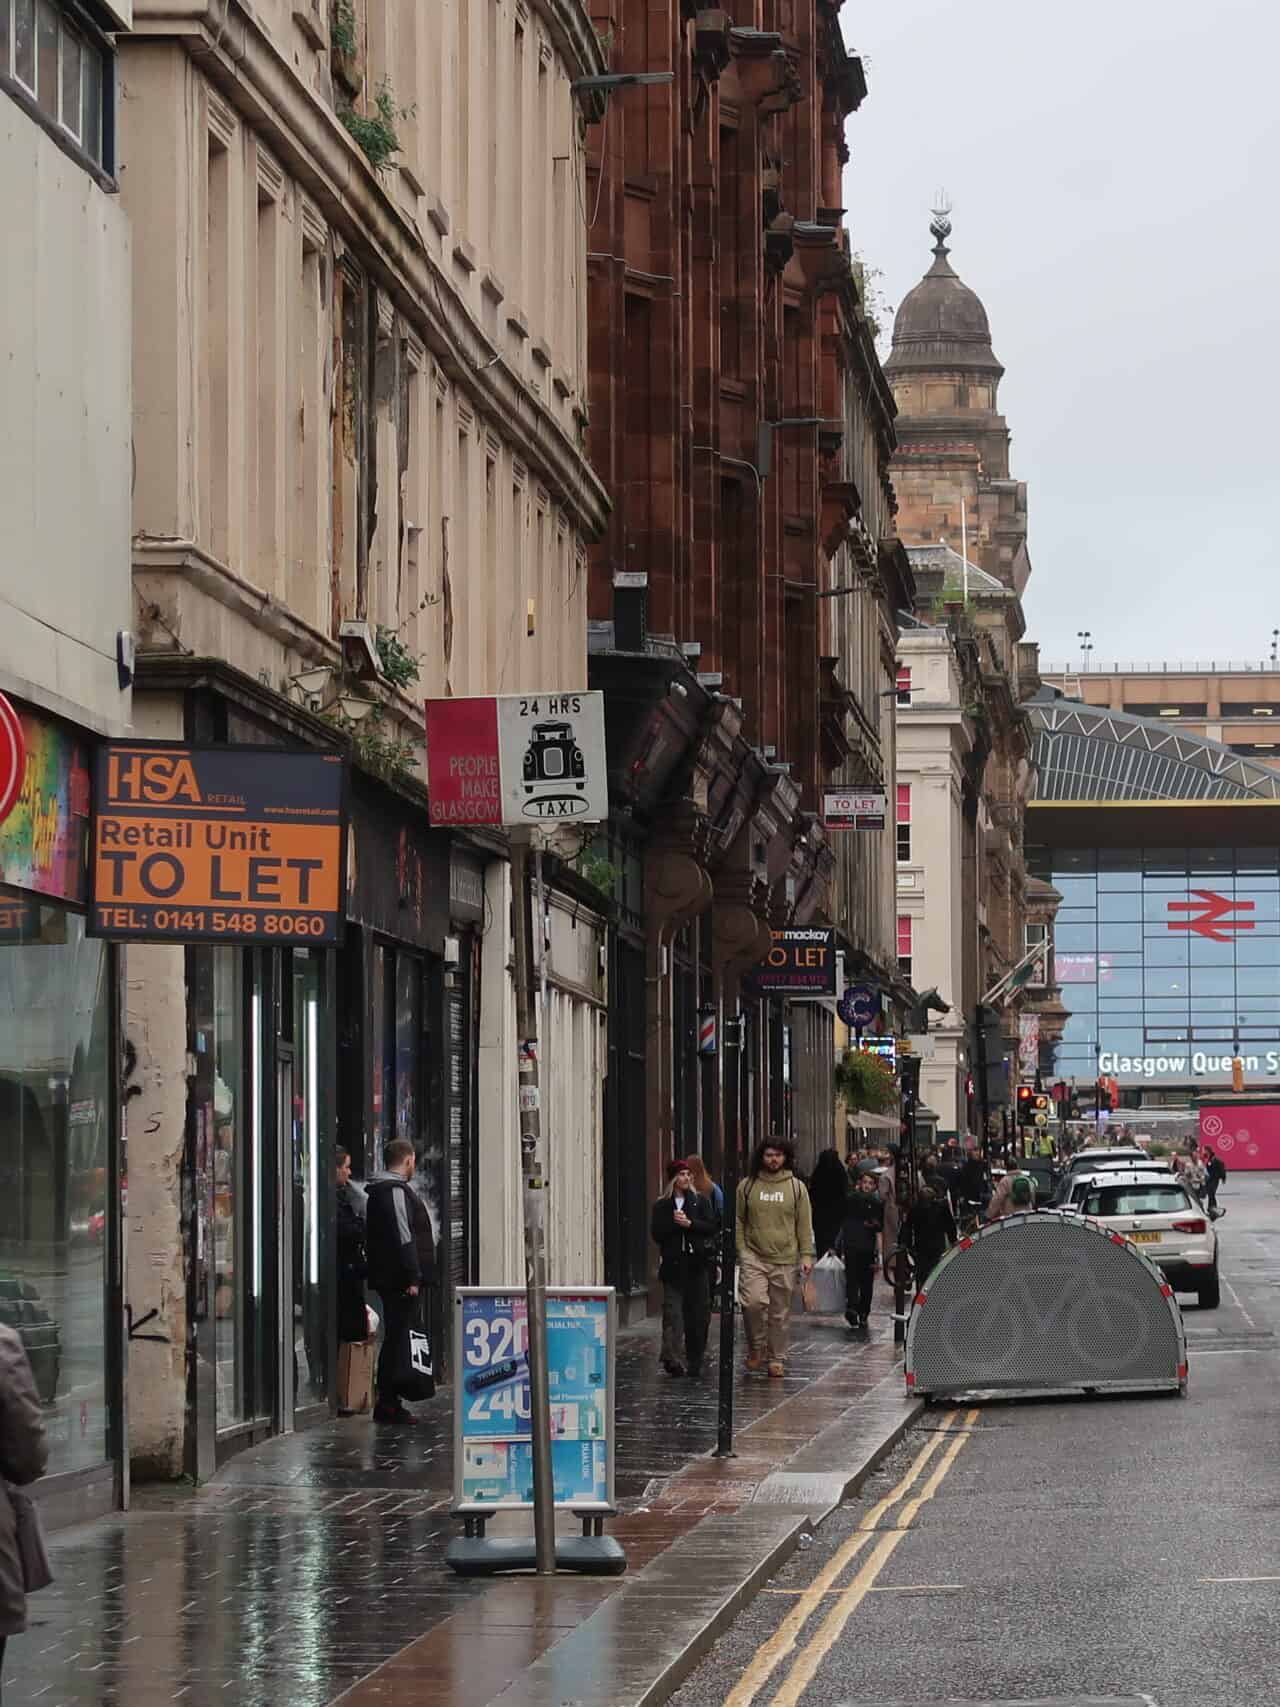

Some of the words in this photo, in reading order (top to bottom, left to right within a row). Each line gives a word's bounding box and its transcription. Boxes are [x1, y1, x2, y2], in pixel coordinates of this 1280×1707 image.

[519, 701, 540, 716] 24
[549, 698, 581, 715] HRS
[450, 755, 498, 777] PEOPLE
[108, 755, 201, 802] HSA
[461, 778, 498, 798] MAKE
[207, 793, 247, 806] RETAIL
[431, 800, 498, 820] GLASGOW
[536, 800, 575, 816] TAXI
[832, 799, 850, 809] TO
[854, 799, 876, 809] LET
[100, 819, 193, 849] Retail
[205, 824, 271, 851] Unit
[101, 850, 185, 898] TO
[210, 855, 323, 905] LET
[98, 908, 147, 928] TEL:
[154, 910, 205, 930] 0141
[212, 912, 256, 933] 548
[263, 915, 325, 935] 8060
[795, 946, 827, 968] LET
[1099, 1052, 1185, 1076] Glasgow
